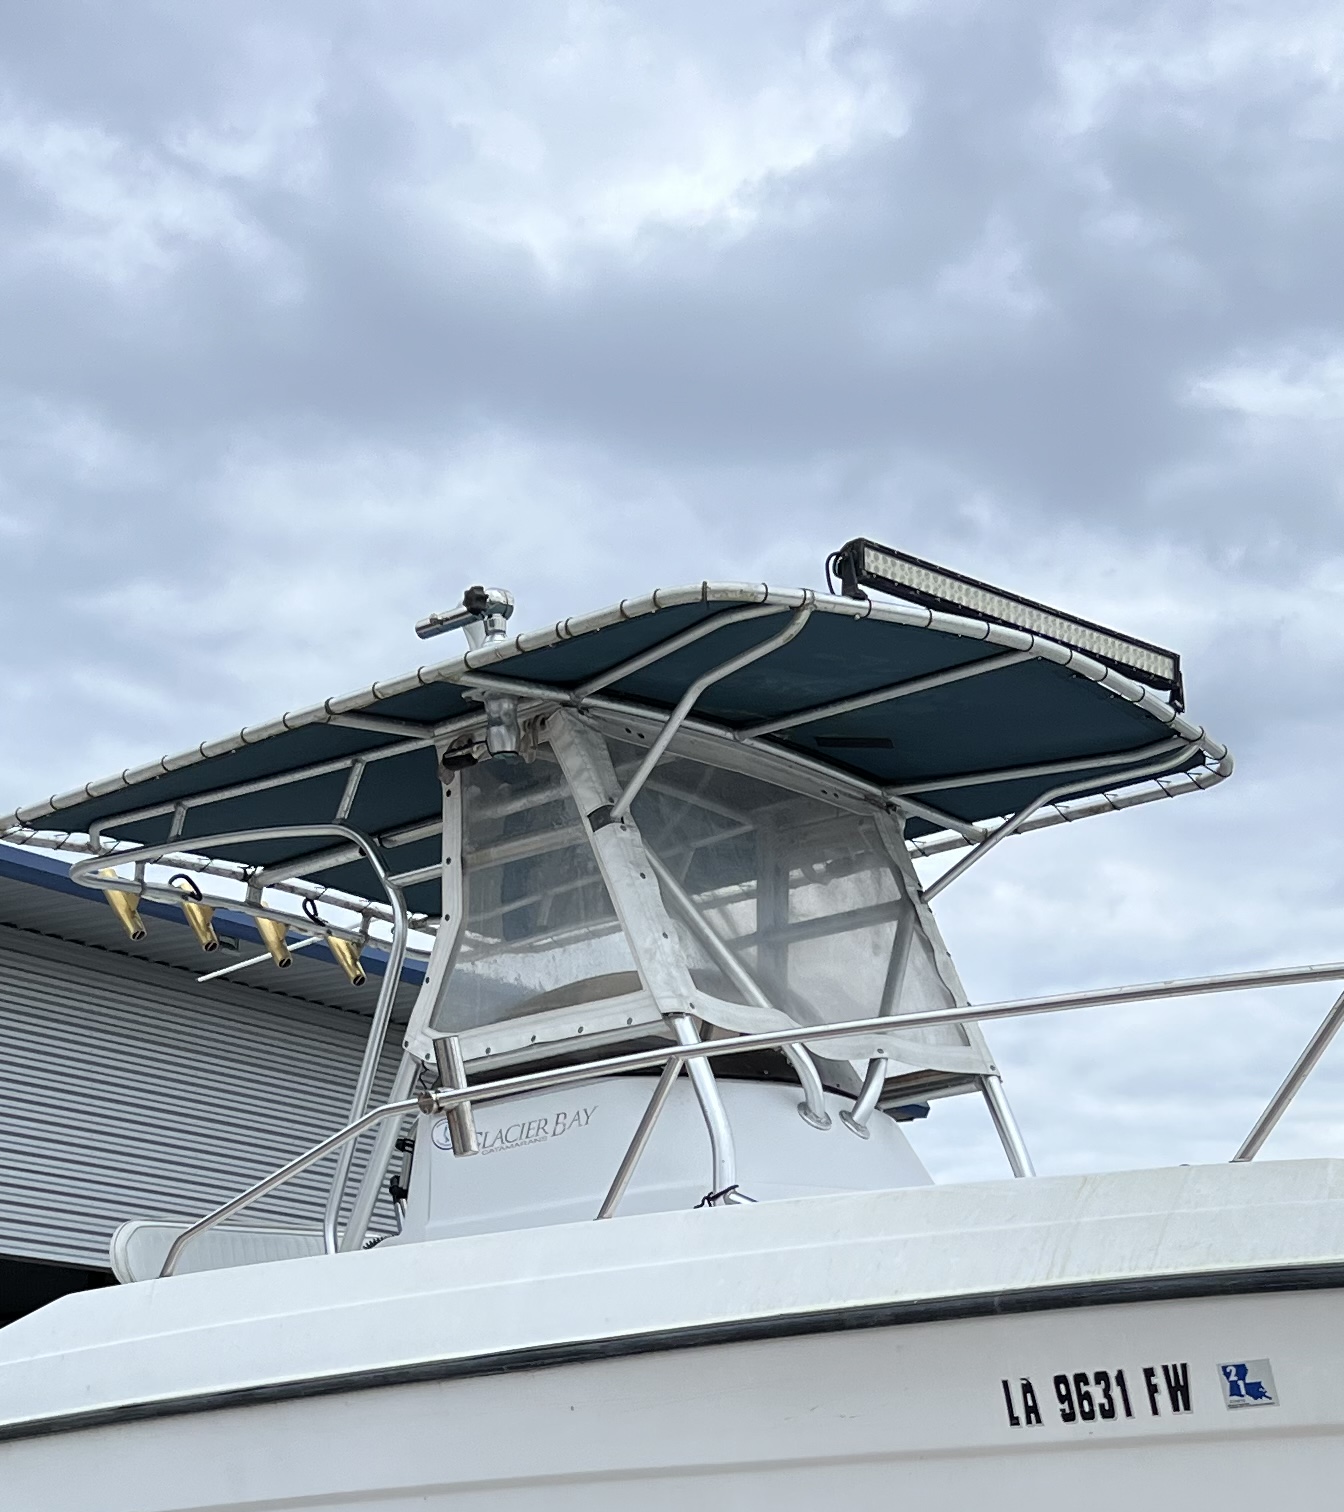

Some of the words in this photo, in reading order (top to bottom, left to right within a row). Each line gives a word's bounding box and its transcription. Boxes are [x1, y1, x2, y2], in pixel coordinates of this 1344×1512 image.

[551, 1105, 598, 1138] BAY
[1001, 1378, 1043, 1427] LA
[1053, 1369, 1133, 1423] 9631
[1143, 1363, 1192, 1417] FW
